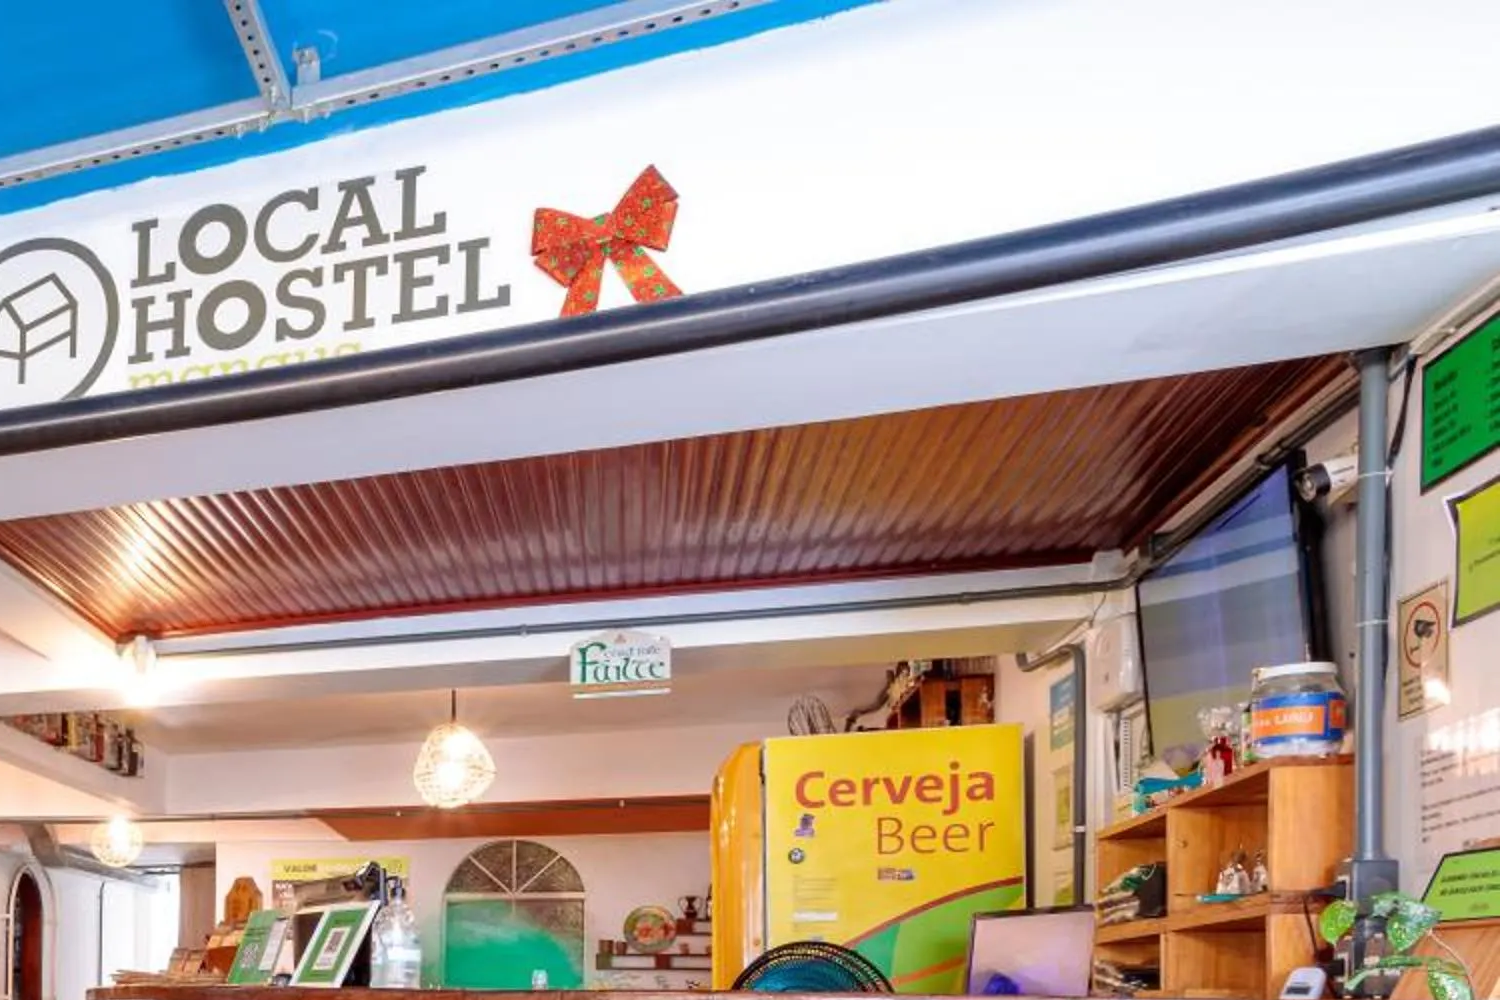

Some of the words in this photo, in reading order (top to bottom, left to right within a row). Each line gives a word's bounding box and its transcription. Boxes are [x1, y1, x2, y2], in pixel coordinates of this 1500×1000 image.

[130, 166, 447, 288] LOCAL
[128, 238, 511, 364] HOSTEL
[794, 760, 996, 816] Cerveja
[876, 815, 996, 856] Beer
